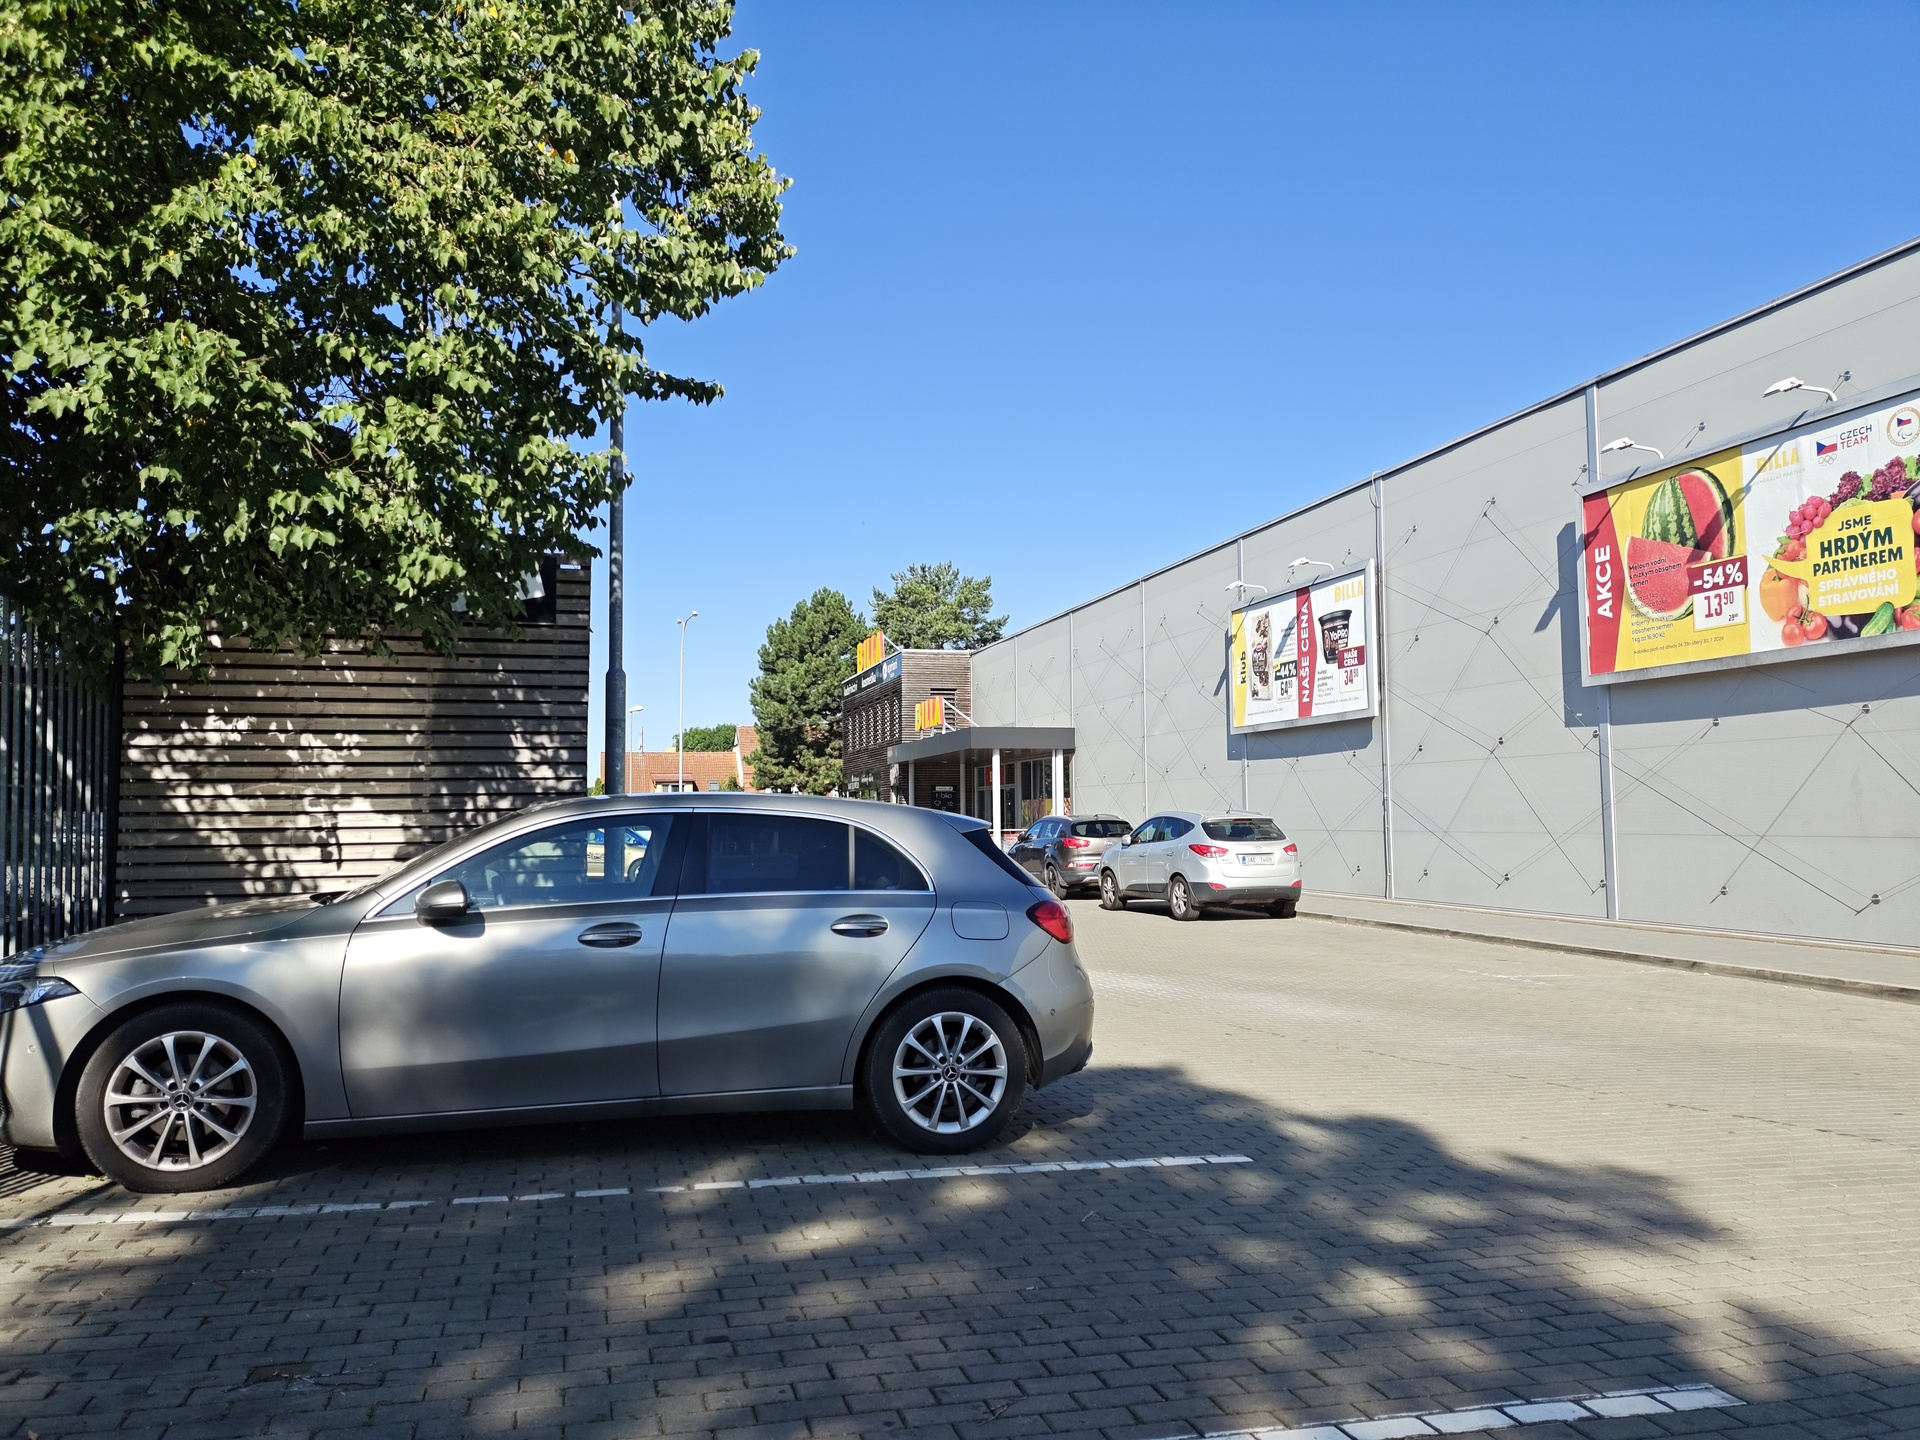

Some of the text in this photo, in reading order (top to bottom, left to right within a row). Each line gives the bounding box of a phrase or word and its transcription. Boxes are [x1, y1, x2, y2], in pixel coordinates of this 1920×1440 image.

[1839, 424, 1873, 441] CZECH
[1840, 434, 1869, 450] TEAM
[1756, 447, 1799, 474] BILLA
[1837, 514, 1872, 532] JSME
[1820, 526, 1893, 559] HRDÝM
[1655, 562, 1682, 574] obsahem
[1812, 546, 1903, 577] PARTNEREM
[1594, 544, 1613, 619] AKCE
[1629, 579, 1649, 588] semen
[1693, 562, 1743, 589] -54%
[1818, 568, 1897, 593] SPRÁVNÉHO
[1334, 579, 1364, 603] BILLA
[1818, 580, 1900, 607] STRAVOVÁNÍ
[857, 630, 884, 674] BILLA
[1300, 601, 1310, 702] NAŠE CENA
[1343, 648, 1358, 659] NAŠE
[1343, 657, 1358, 666] CENA
[1276, 662, 1297, 678] -44%
[915, 696, 944, 731] BILLA
